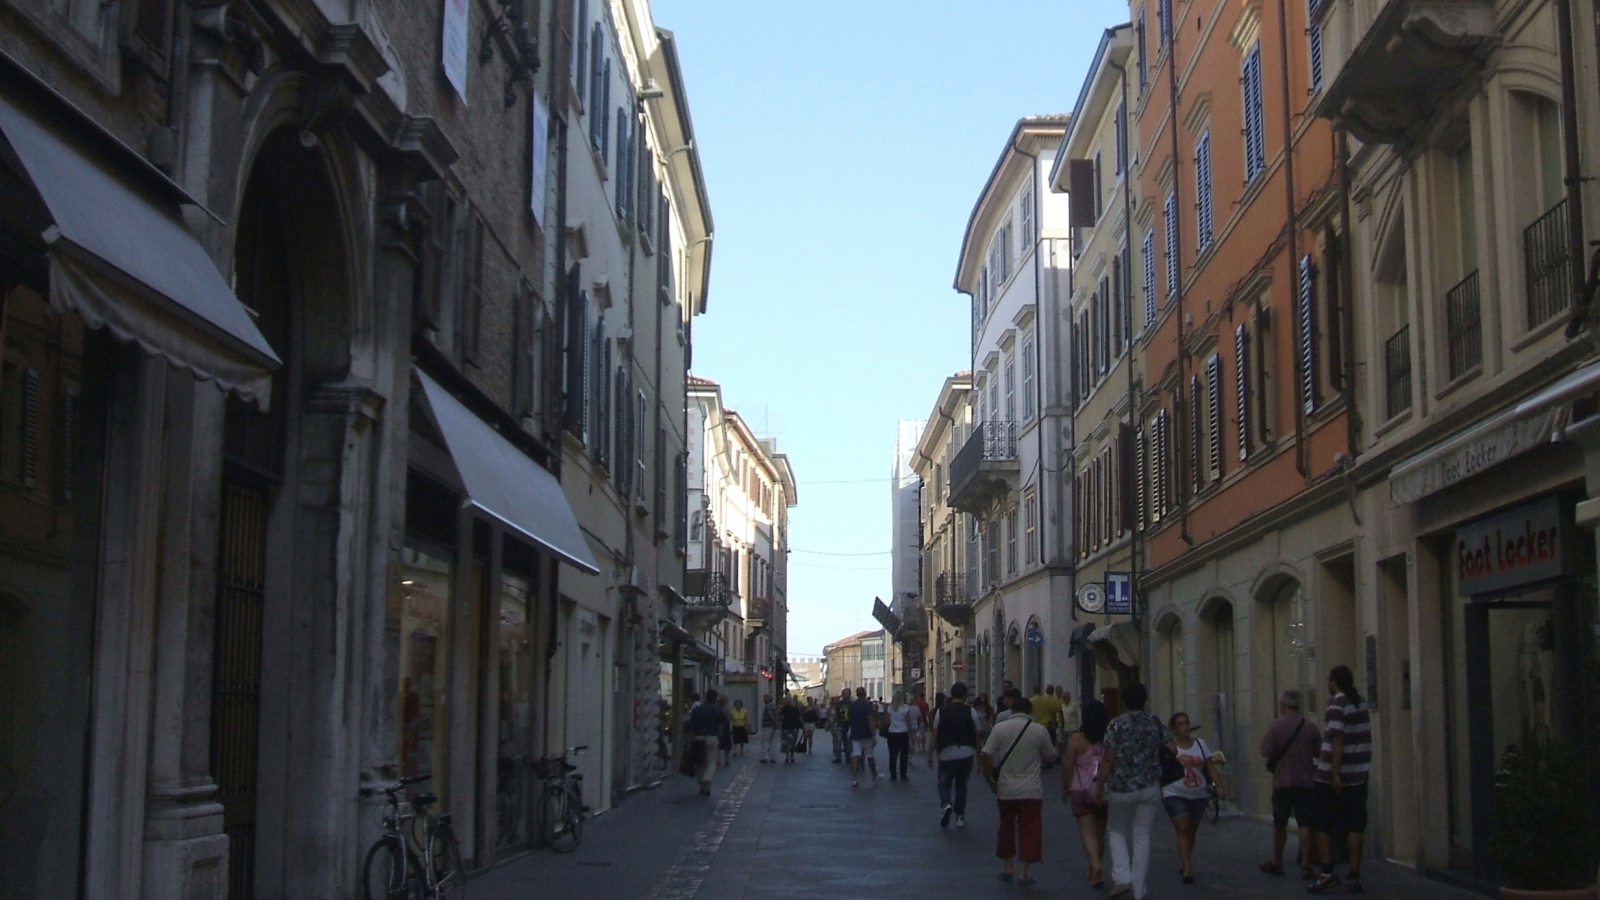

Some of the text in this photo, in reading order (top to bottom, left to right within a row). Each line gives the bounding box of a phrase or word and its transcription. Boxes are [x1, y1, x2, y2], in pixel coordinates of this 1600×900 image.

[1441, 442, 1496, 485] Foot Locker
[1458, 519, 1557, 580] Foot Locker
[1109, 574, 1128, 601] T
